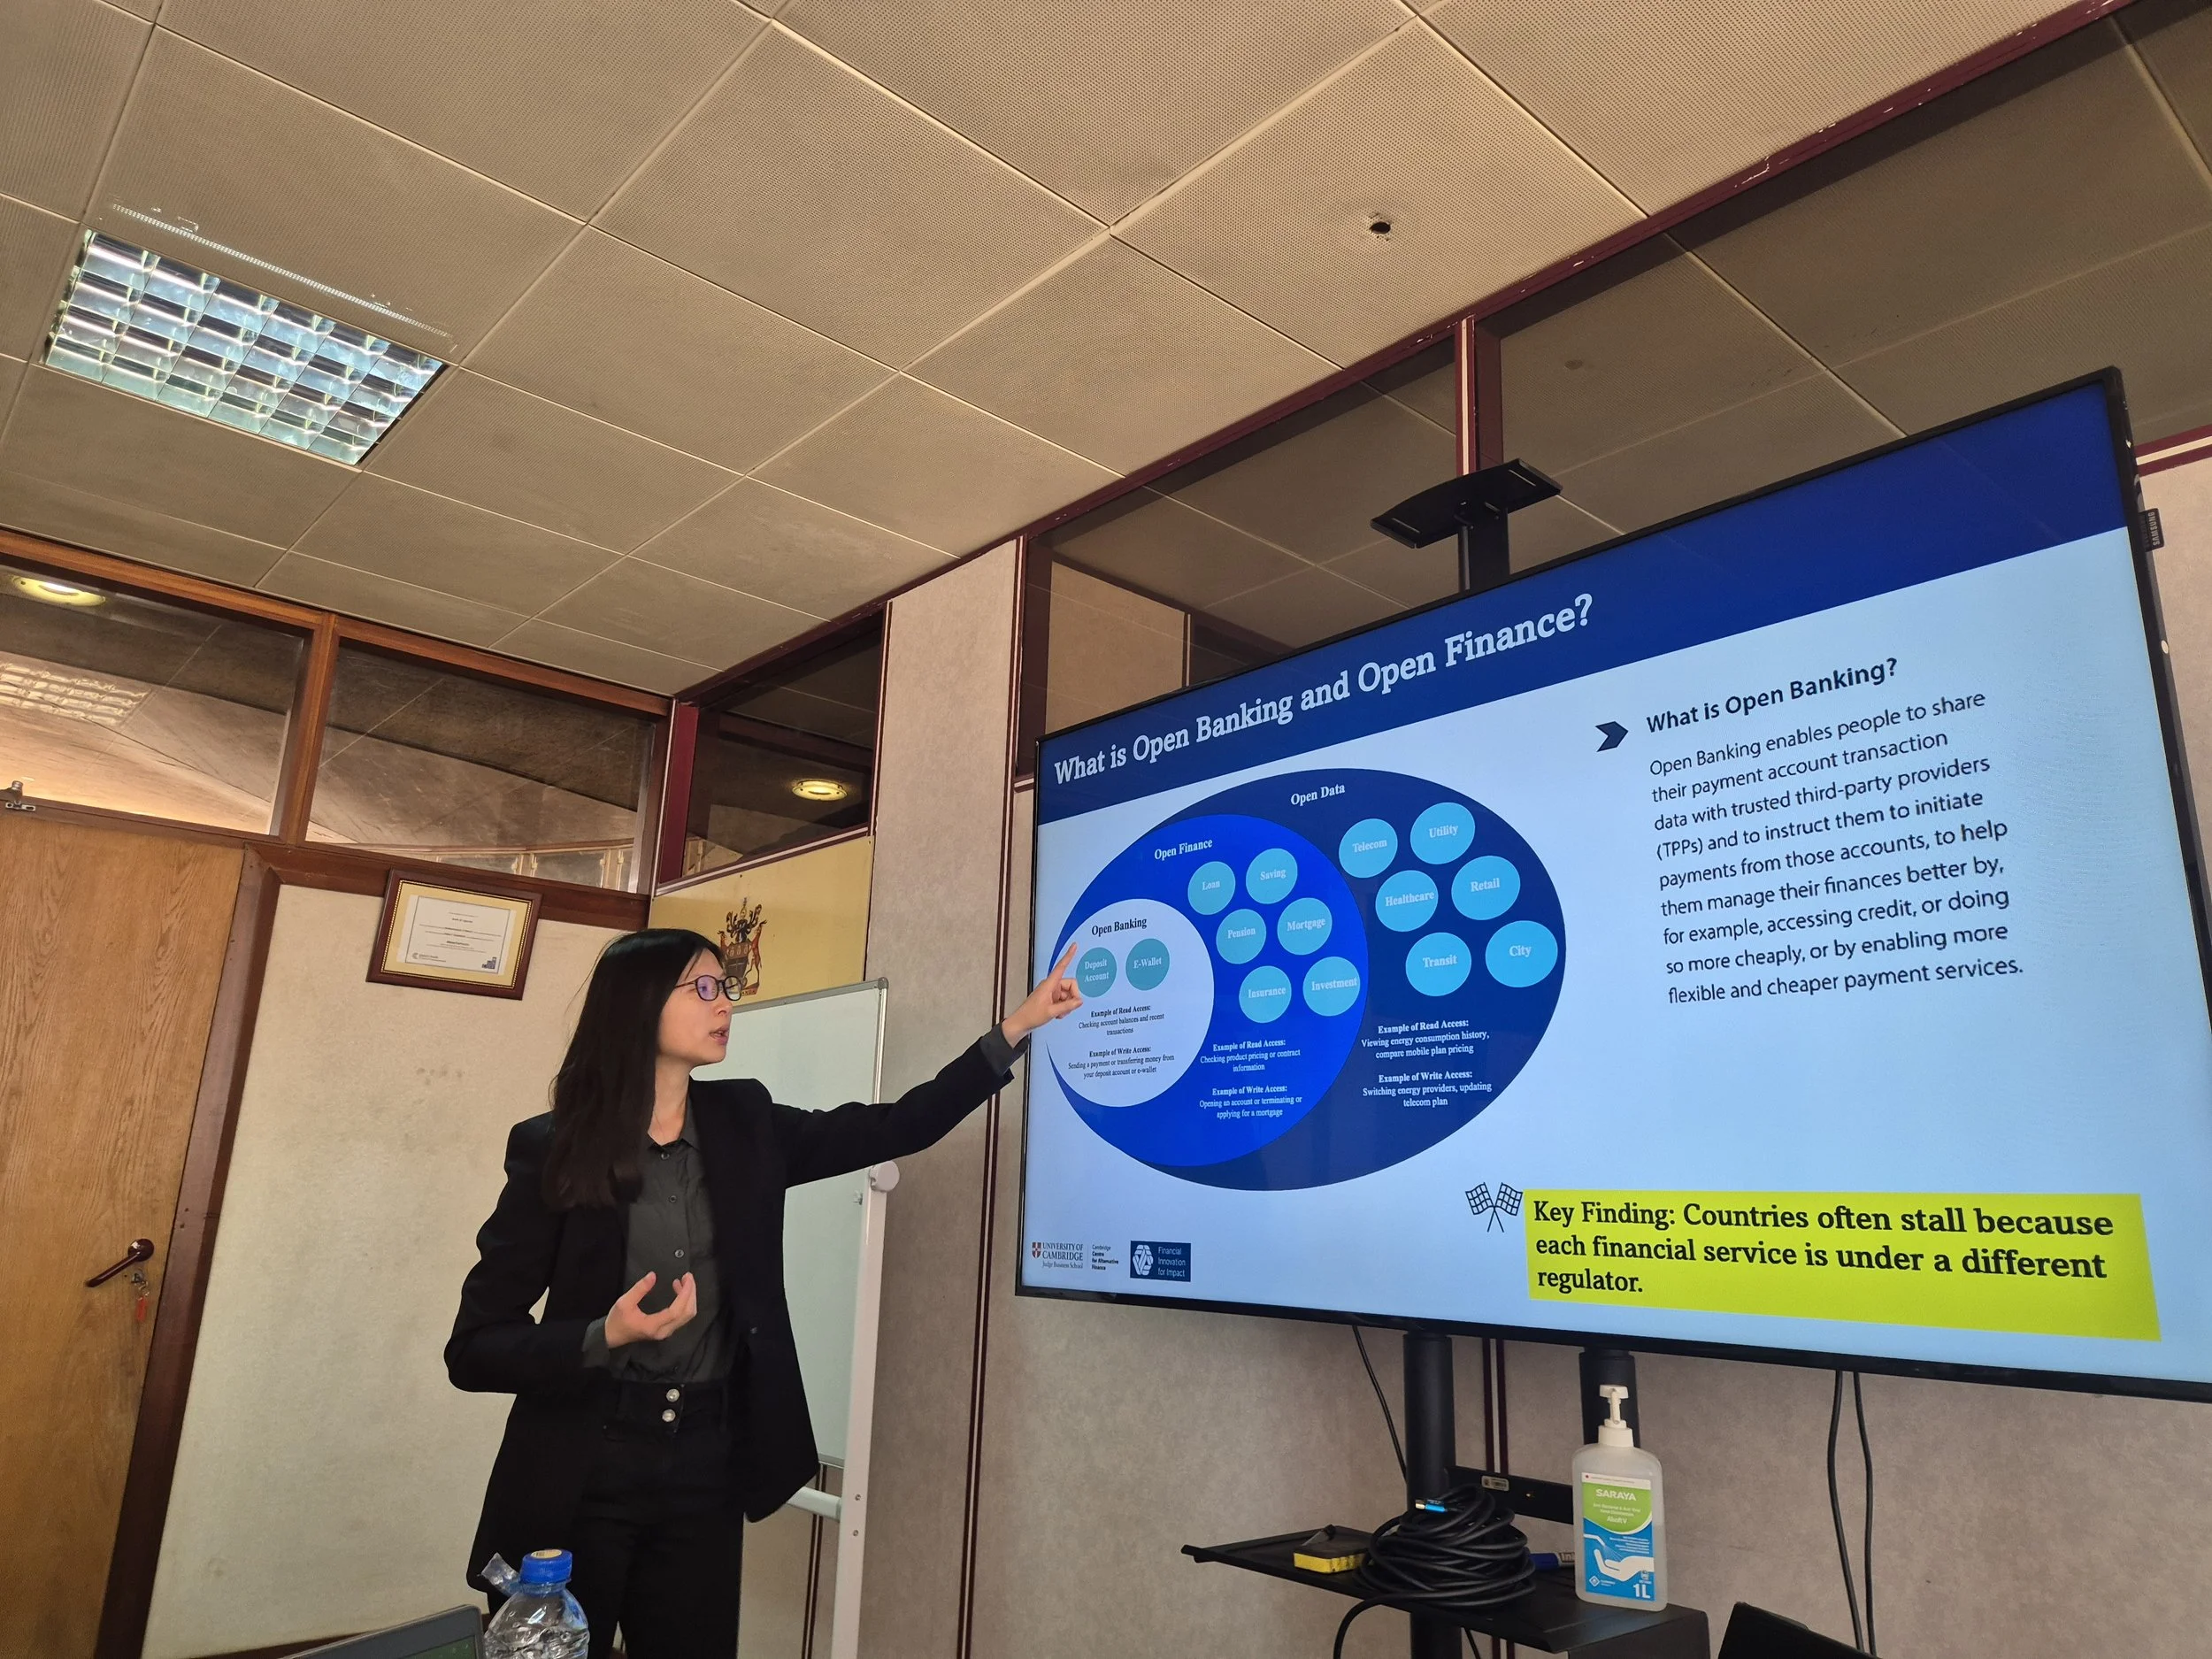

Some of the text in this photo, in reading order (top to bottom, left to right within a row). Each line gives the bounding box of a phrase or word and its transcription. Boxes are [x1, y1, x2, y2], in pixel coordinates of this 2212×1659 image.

[2148, 511, 2161, 546] SAMSUNG
[1055, 594, 1593, 784] What is Open Banking and Open Finance?
[1647, 657, 1897, 733] What is Open Banking?
[1650, 694, 1985, 777] Open Banking enables people to share
[1652, 733, 1947, 803] their payment account transaction
[1291, 784, 1345, 806] Open Data
[1655, 758, 1990, 831] data with trusted third-party providers
[1429, 825, 1458, 838] Utility
[1657, 793, 1983, 861] (TPPs) and to instruct them to initiate
[1155, 840, 1212, 861] Open Finance
[1353, 840, 1387, 852] Telecom
[1660, 823, 2008, 891] payments from those accounts, to help
[1260, 869, 1286, 881] Saving
[1202, 880, 1220, 891] Loan
[1471, 878, 1500, 892] Retail
[1661, 858, 2004, 917] them manage their finances better by,
[1385, 891, 1434, 907] Healthcare
[1663, 891, 2009, 944] for example, accessing credit, or doing
[1092, 918, 1147, 937] Open Banking
[1286, 918, 1325, 932] Mortgage
[1227, 927, 1256, 939] Pension
[1509, 945, 1532, 957] City
[1666, 926, 2008, 974] so more cheaply, or by enabling more
[1085, 958, 1107, 971] Deposit
[1133, 956, 1162, 969] E-Wallet
[1423, 954, 1457, 968] Transit
[1084, 972, 1109, 982] Account
[1311, 977, 1358, 991] Investment
[1669, 960, 2024, 1003] flexible and cheaper payment services.
[1248, 987, 1286, 999] Insurance
[1378, 1020, 1469, 1034] Example of Read Access:
[1213, 1042, 1238, 1052] Example
[1362, 1039, 1389, 1048] Viewing
[1415, 1033, 1460, 1043] consumption
[1462, 1032, 1489, 1041] history,
[1089, 1049, 1110, 1058] Example
[1376, 1046, 1474, 1060] compare mobile plan pricing
[1379, 1071, 1472, 1084] Example of Write Access:
[1212, 1087, 1238, 1097] Example
[1363, 1083, 1493, 1097] Switching energy providers, updating
[1403, 1097, 1448, 1108] telecom plan
[1533, 1201, 2113, 1235] Key Finding: Countries often stall because
[1042, 1251, 1083, 1261] CAMBRIDGE
[1158, 1256, 1186, 1265] Innovation
[1536, 1234, 2107, 1279] each financial service is under a different
[1167, 1269, 1185, 1278] Impact
[1538, 1272, 1643, 1294] regulator.
[1596, 1488, 1636, 1501] SARAYA
[1633, 1584, 1651, 1598] 1L
